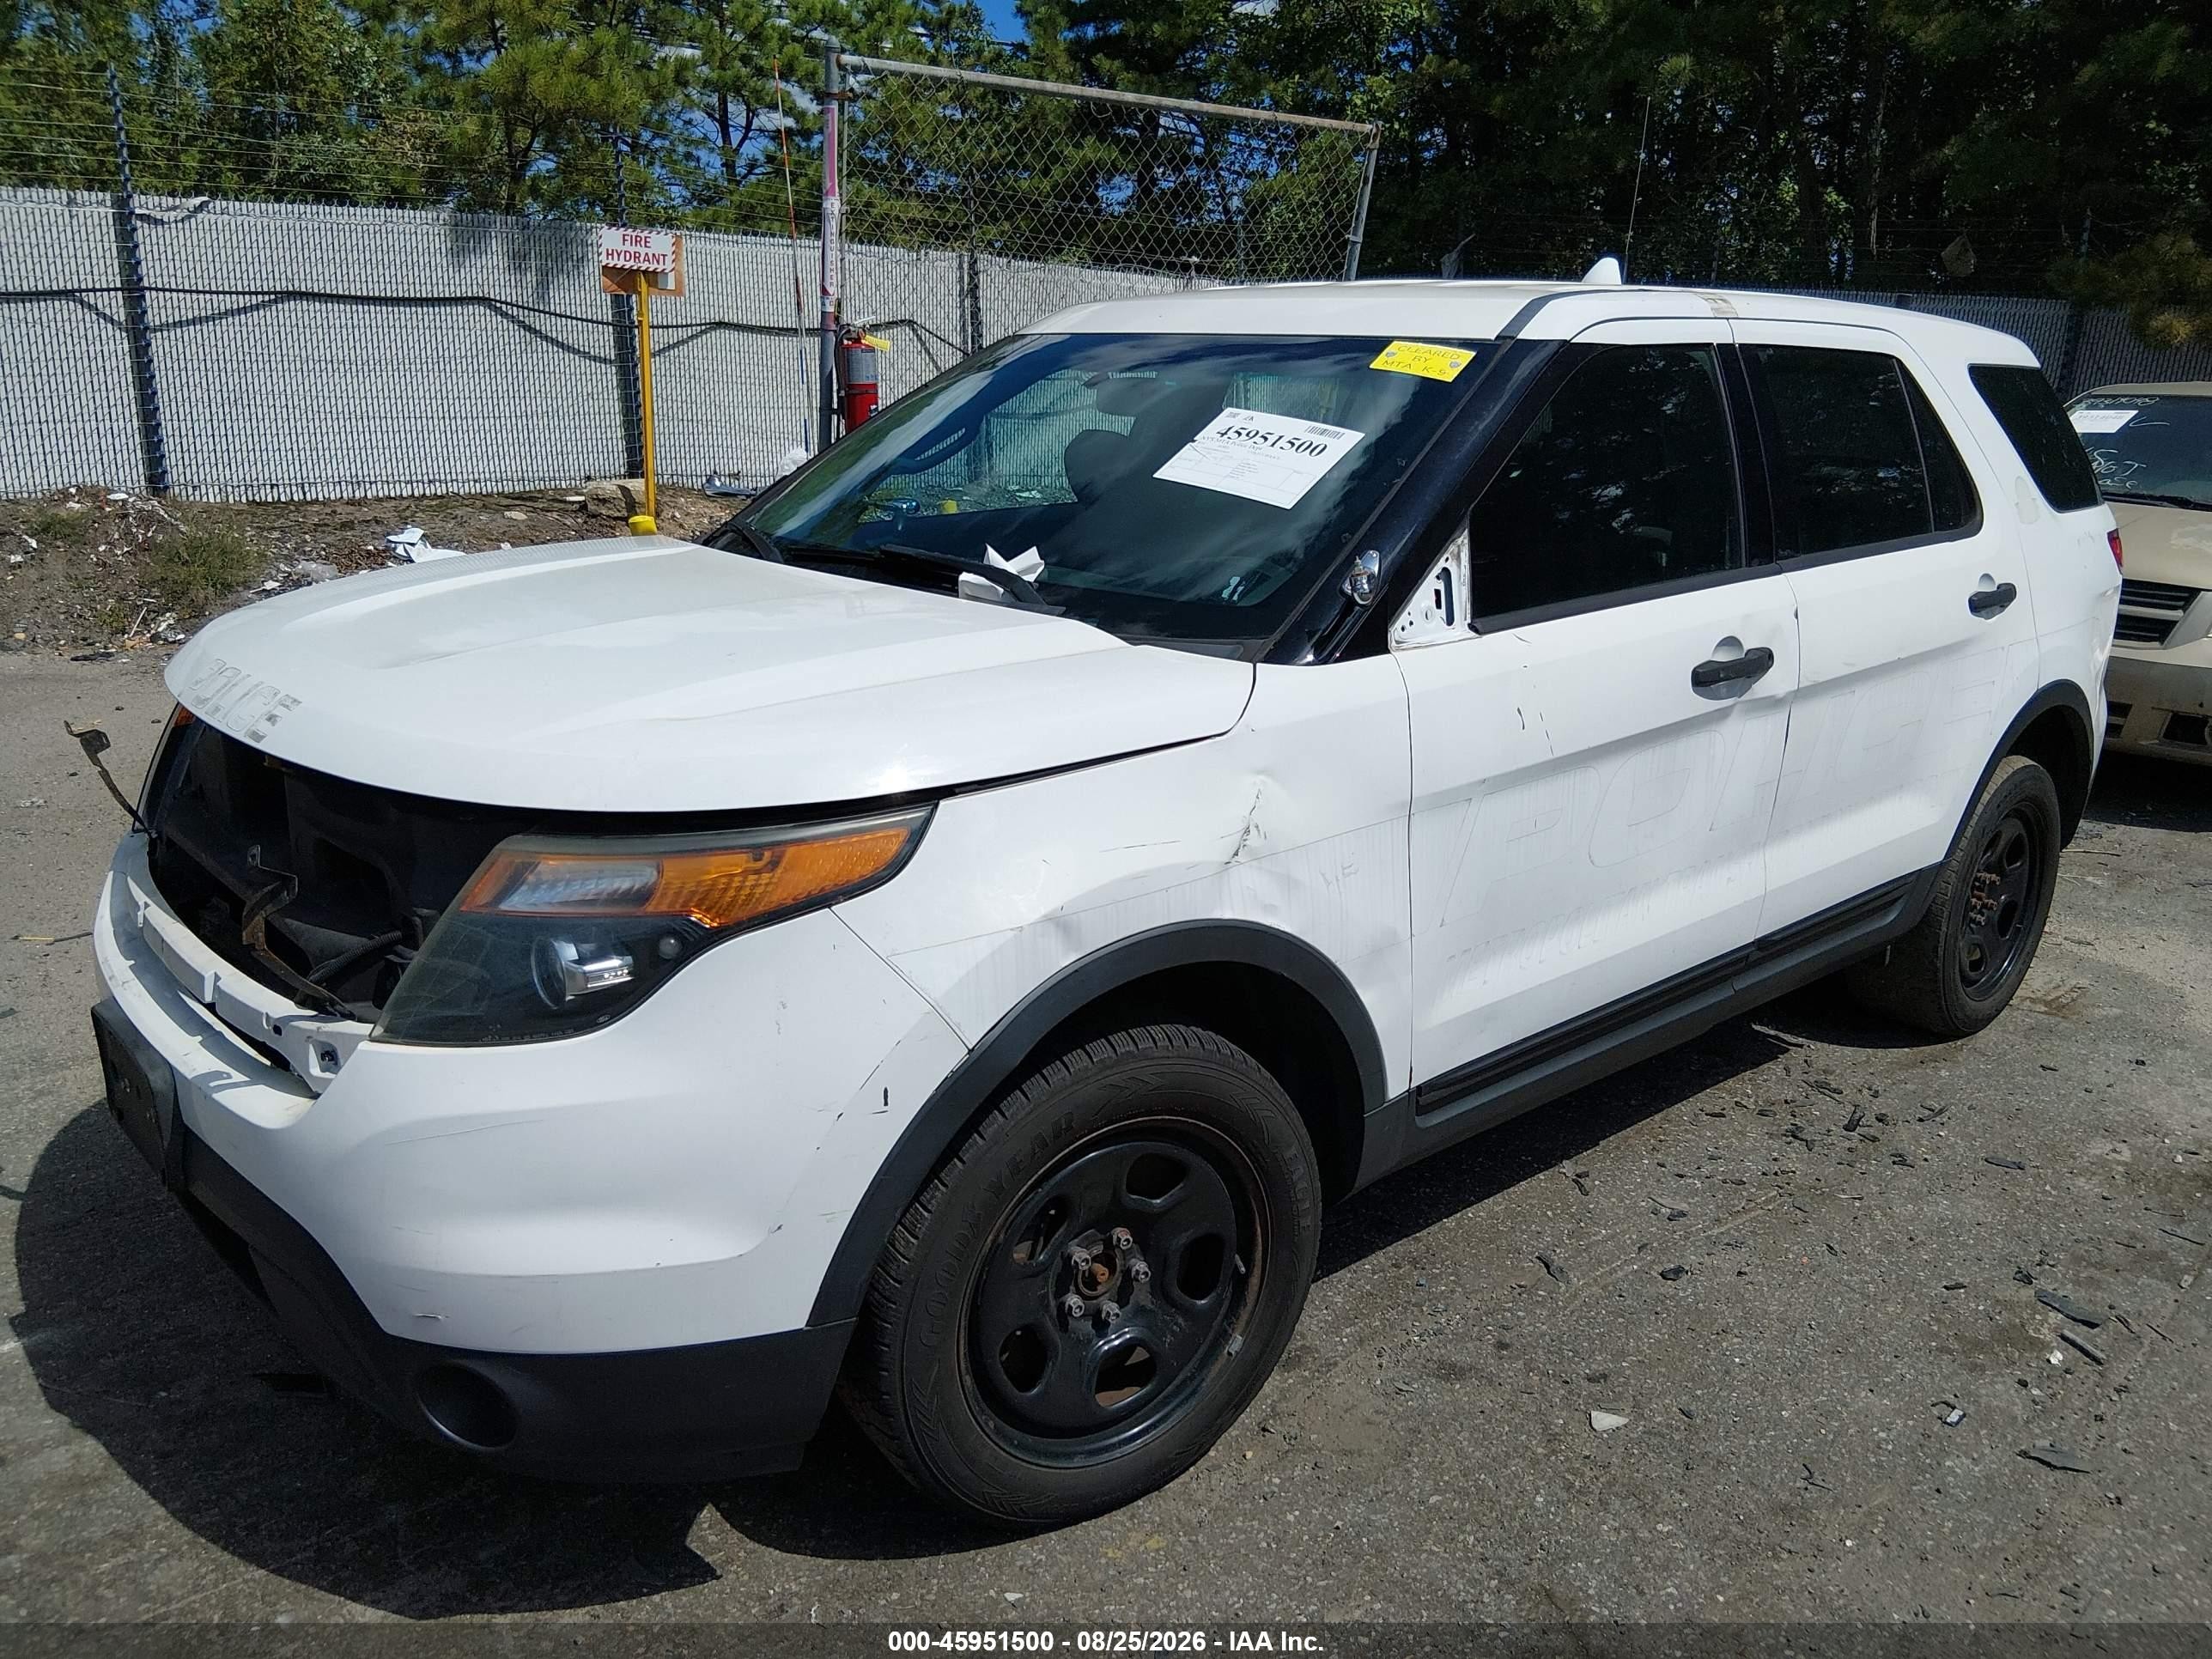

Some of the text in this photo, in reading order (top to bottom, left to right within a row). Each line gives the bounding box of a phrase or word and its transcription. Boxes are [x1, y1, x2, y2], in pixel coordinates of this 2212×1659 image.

[623, 233, 652, 249] FIRE
[605, 248, 668, 266] HYDRANT
[1397, 345, 1461, 360] CLEARED
[1382, 360, 1412, 370] MTA
[1216, 425, 1328, 458] 45951500
